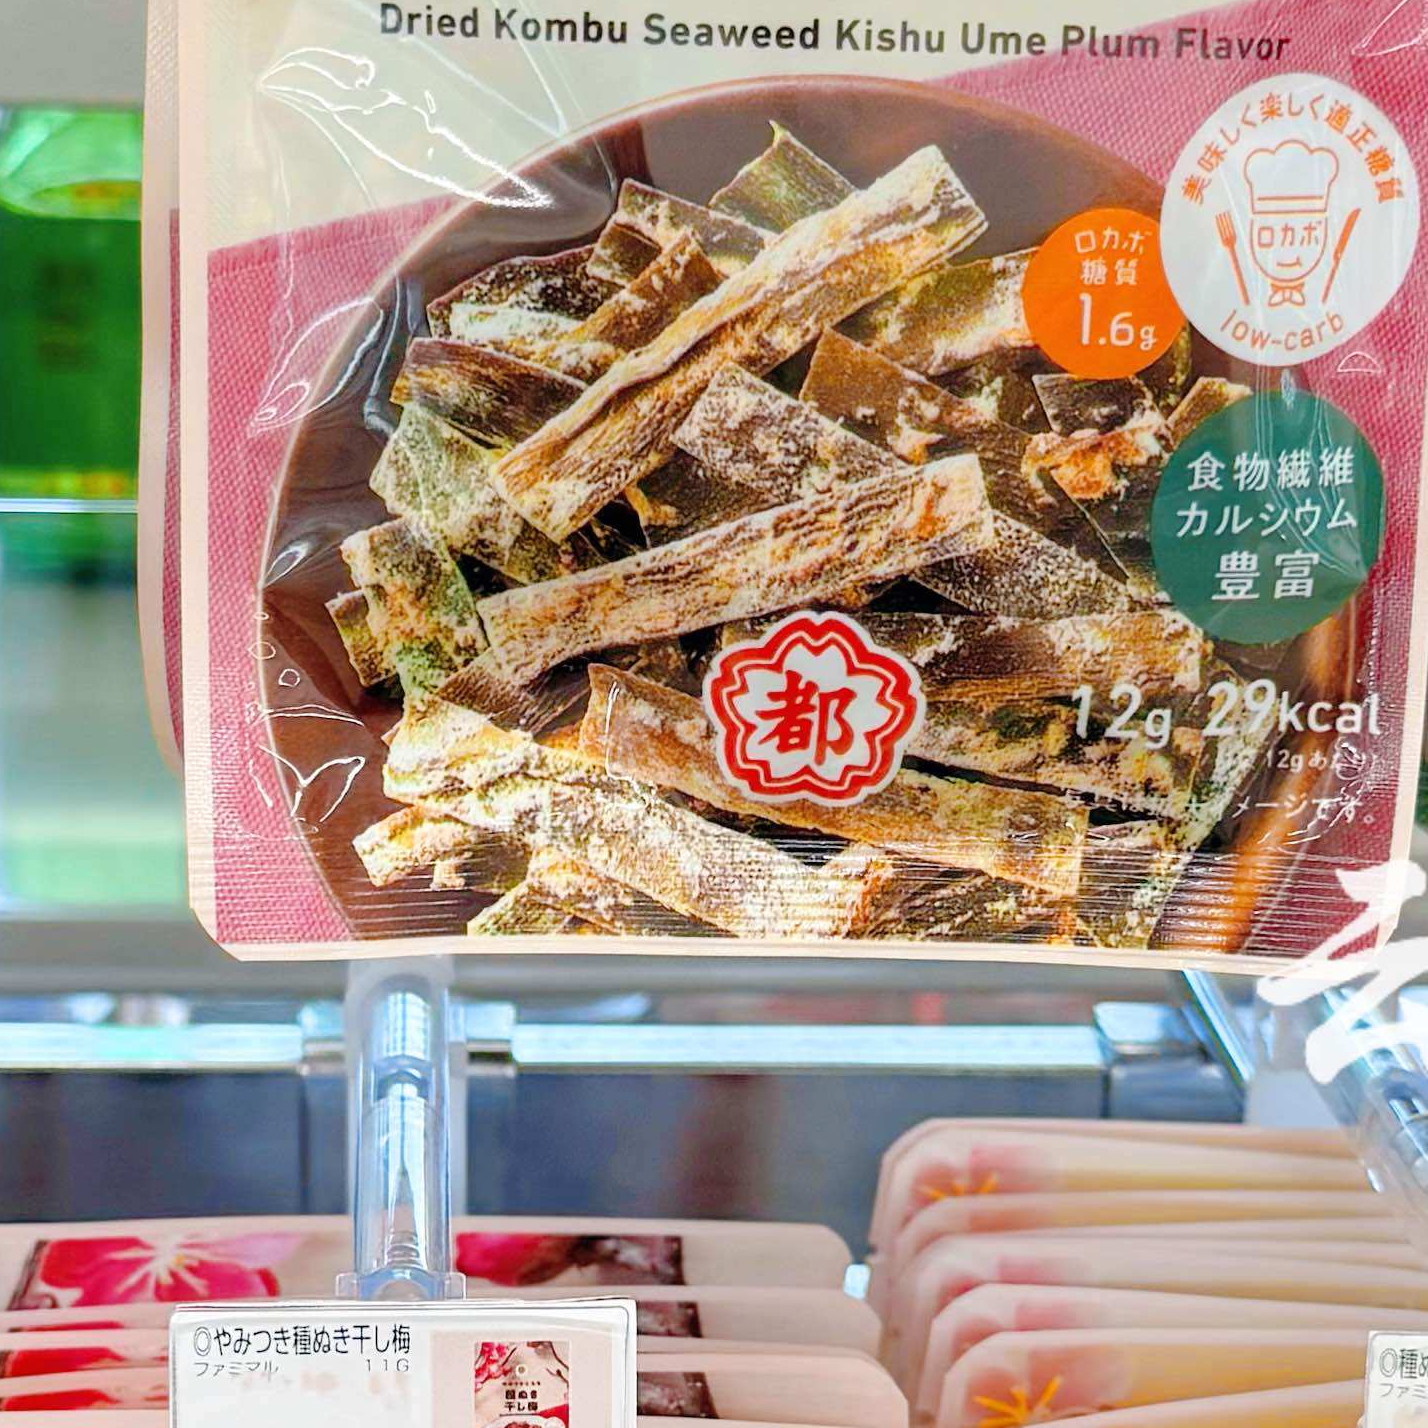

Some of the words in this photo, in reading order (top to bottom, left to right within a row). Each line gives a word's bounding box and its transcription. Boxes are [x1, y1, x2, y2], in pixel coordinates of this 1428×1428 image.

[380, 0, 480, 42] Dried
[493, 4, 629, 46] Kombu
[642, 10, 820, 53] Seaweed
[834, 14, 948, 58] Kishu
[960, 20, 1047, 60] Ume
[1060, 23, 1159, 61] Plum
[1174, 25, 1291, 63] Flavor
[1178, 91, 1405, 208] 美味しく楽しく適正糖質
[1075, 225, 1150, 255] ロカボ
[1257, 220, 1319, 249] ロカボ
[1079, 257, 1139, 287] 糖質
[1078, 291, 1158, 352] 1.6g
[1219, 309, 1347, 353] low-carb
[1185, 448, 1356, 493] 食物繊維
[1175, 500, 1359, 539] カルシウム
[1210, 547, 1321, 601] 豊富
[753, 669, 856, 767] 都
[1071, 682, 1172, 749] 12g
[1202, 678, 1381, 737] 29kcal
